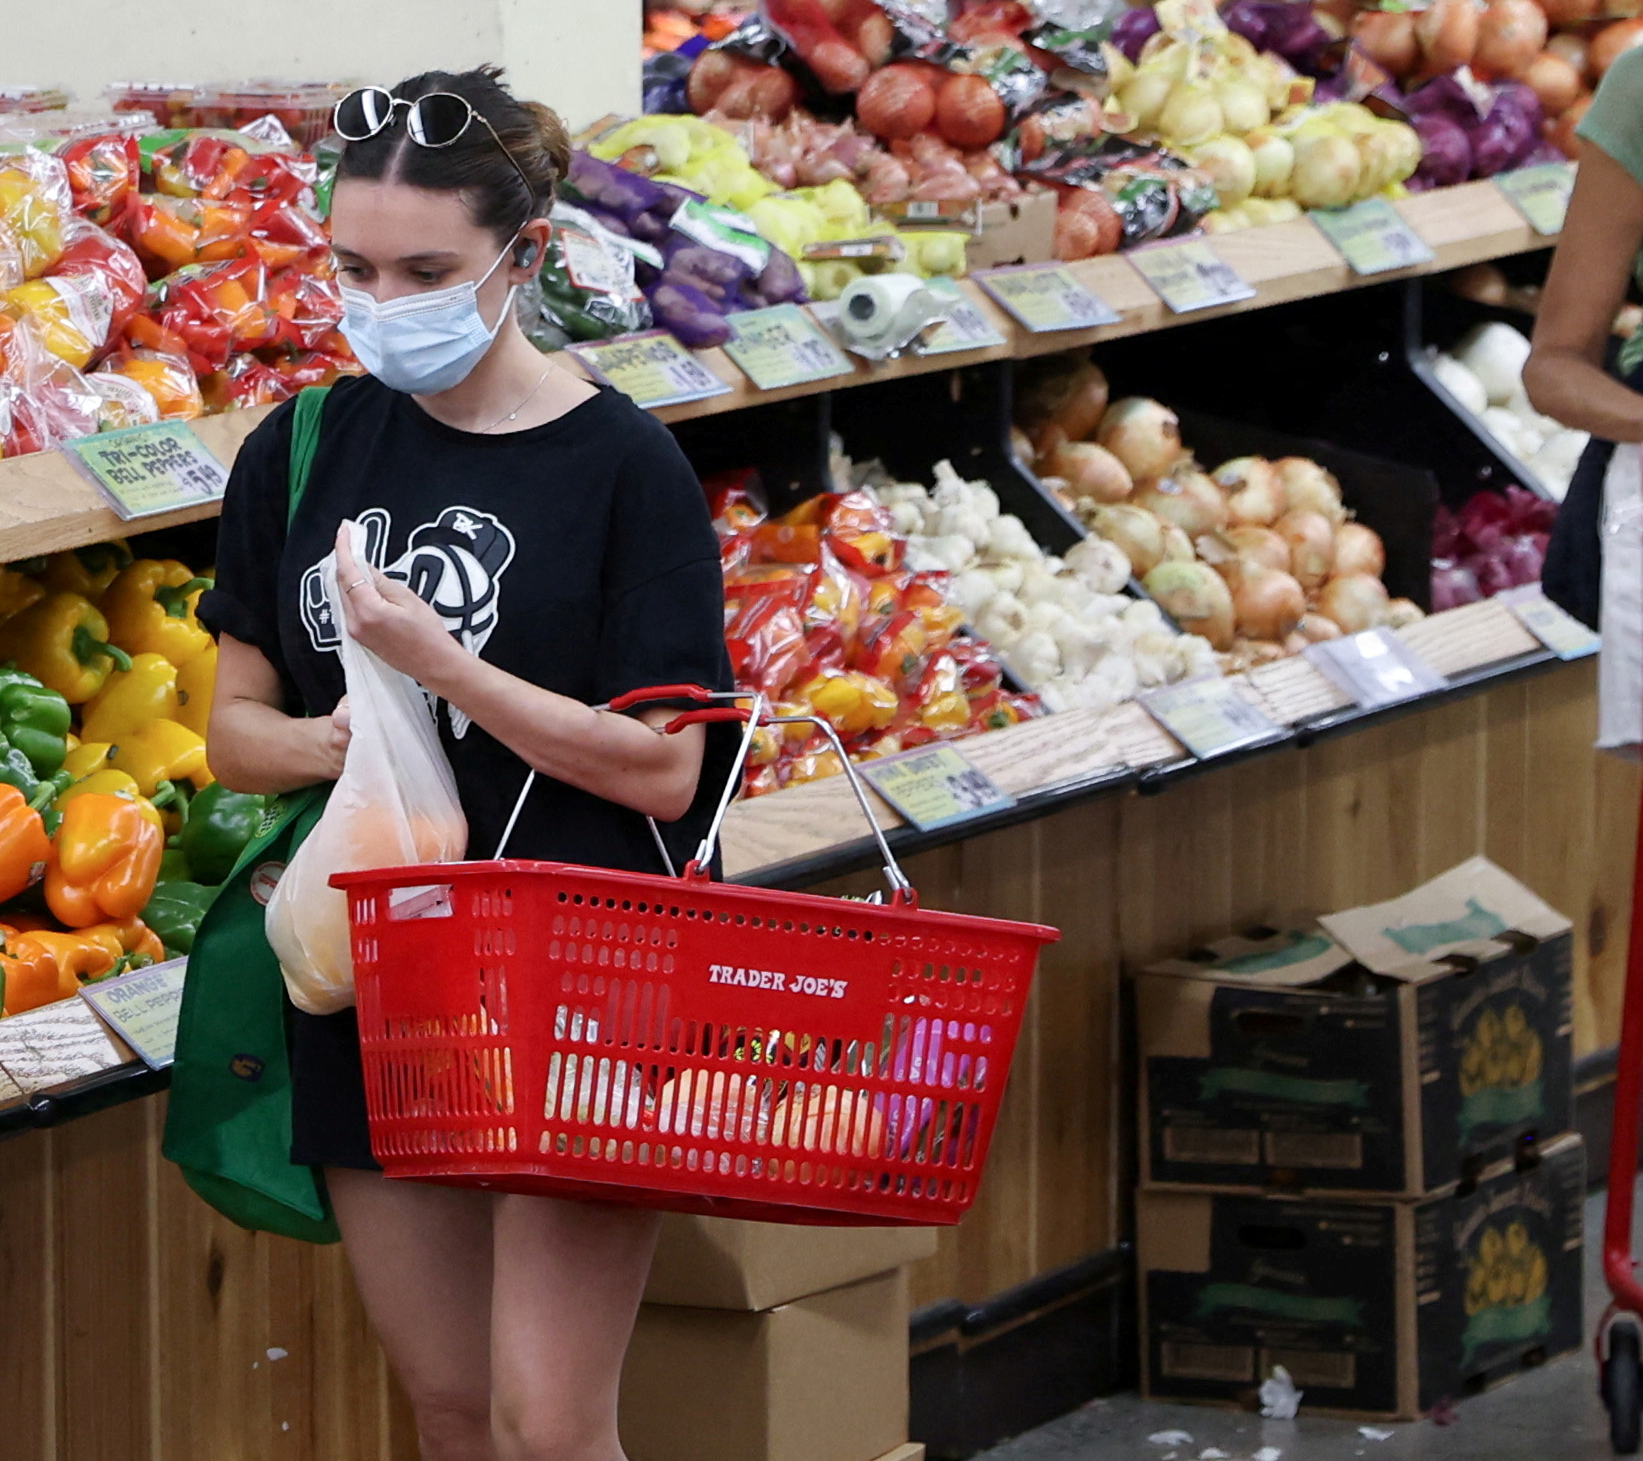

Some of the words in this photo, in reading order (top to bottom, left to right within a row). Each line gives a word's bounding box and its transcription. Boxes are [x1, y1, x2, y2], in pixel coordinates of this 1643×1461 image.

[98, 437, 183, 467] TRI-COLOR
[105, 464, 147, 485] BELL
[140, 450, 198, 479] PEPPERS
[106, 972, 169, 1004] ORANGE
[708, 964, 786, 997] TRADER
[788, 970, 849, 999] JOE'S
[113, 1004, 148, 1024] BELL
[145, 987, 184, 1009] PEPP
